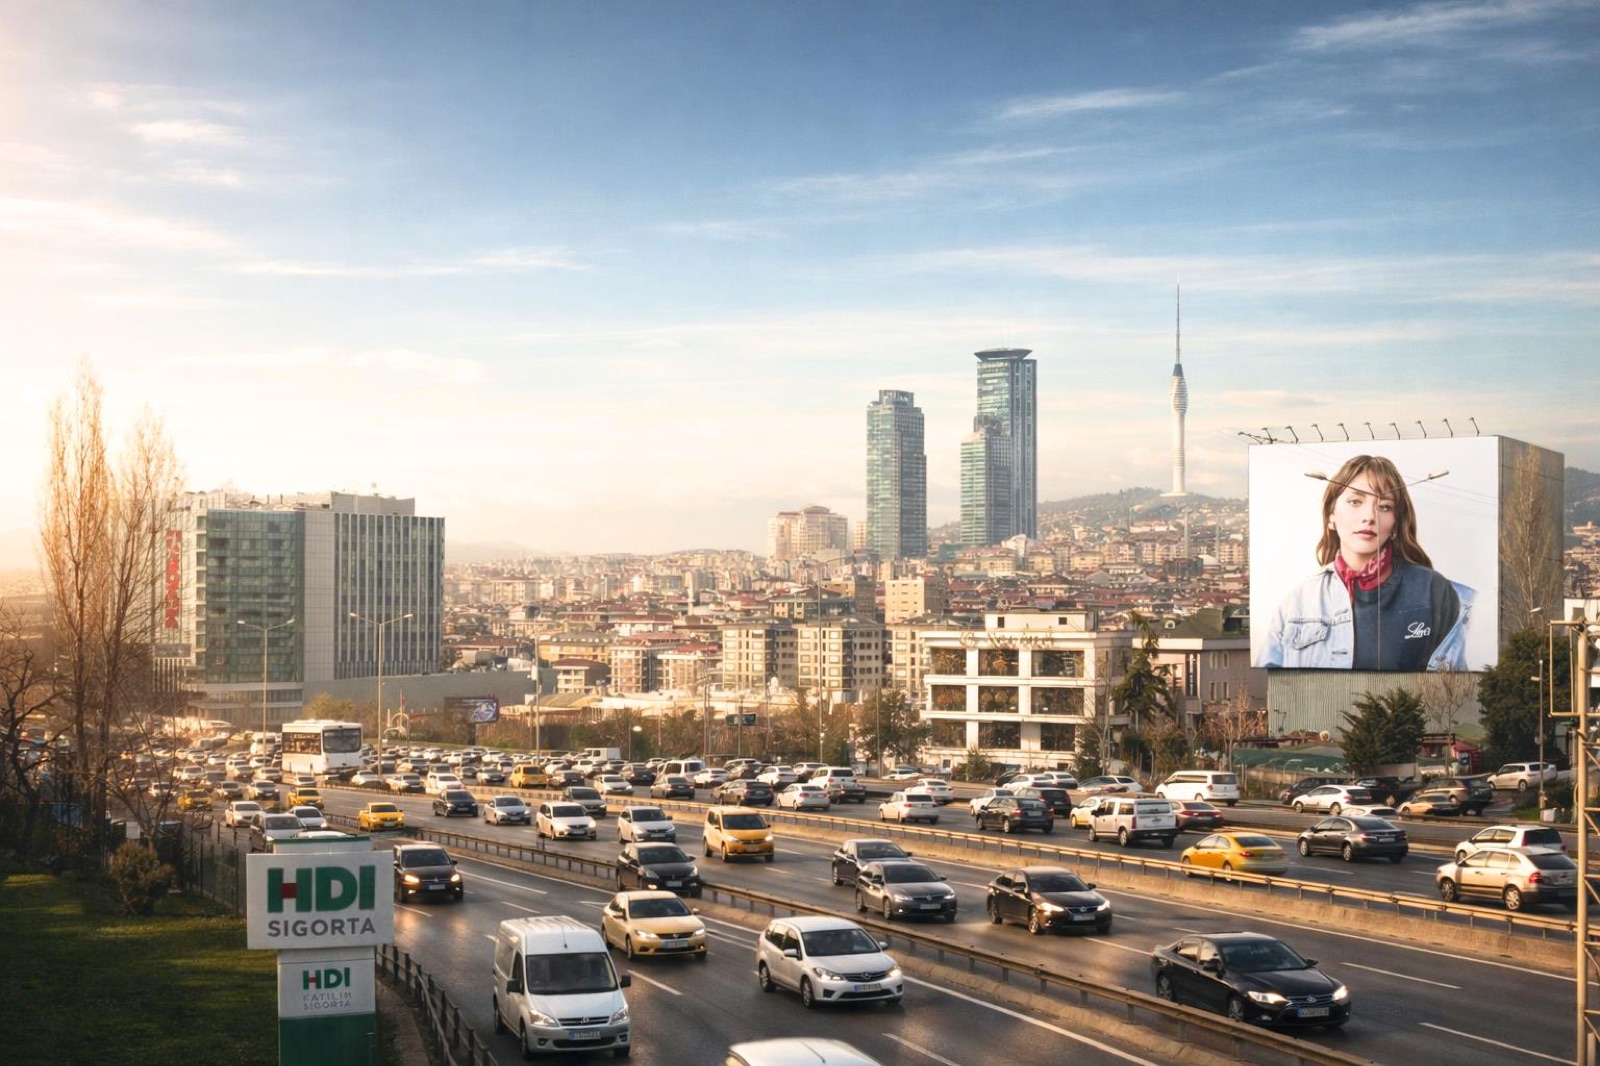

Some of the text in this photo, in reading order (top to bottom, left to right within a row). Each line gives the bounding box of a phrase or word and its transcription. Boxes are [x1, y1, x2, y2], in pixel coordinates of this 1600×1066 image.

[267, 865, 376, 913] HDI
[267, 917, 376, 937] SIGORTA
[302, 967, 351, 990] HDI
